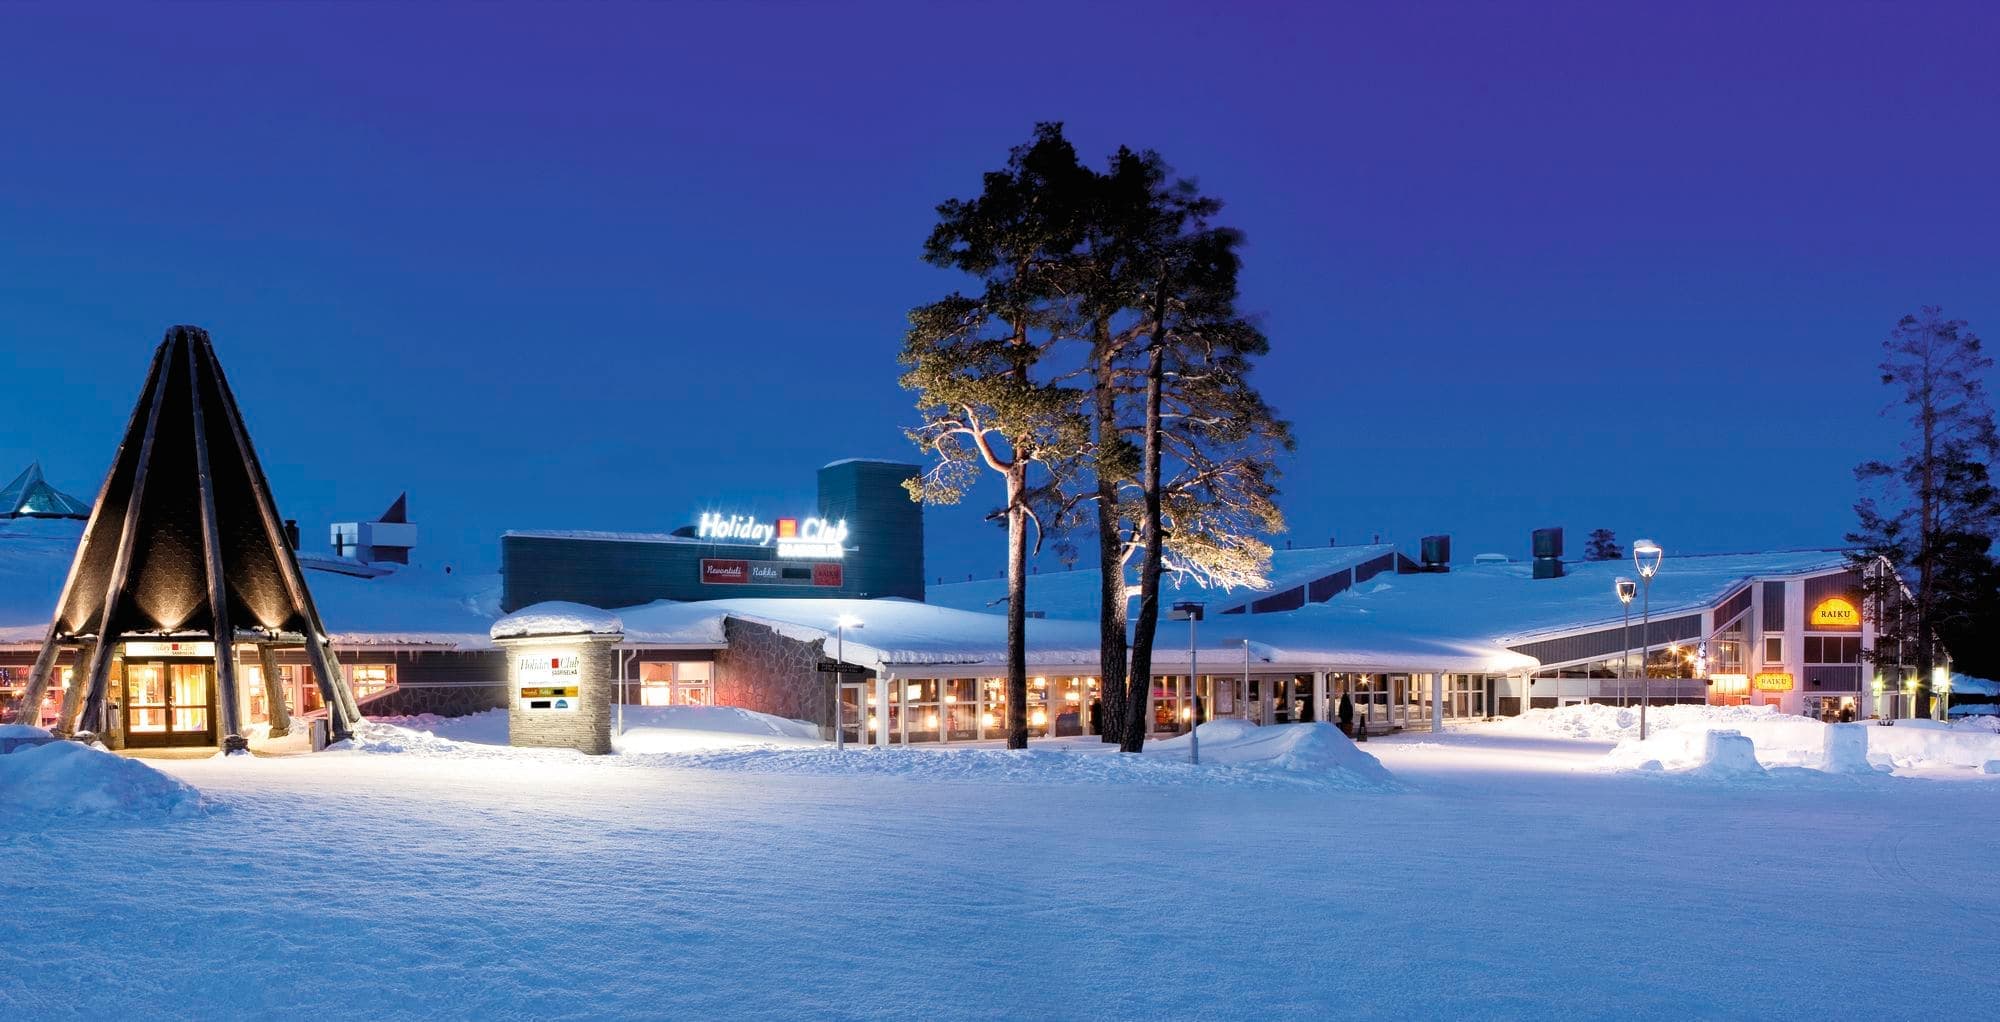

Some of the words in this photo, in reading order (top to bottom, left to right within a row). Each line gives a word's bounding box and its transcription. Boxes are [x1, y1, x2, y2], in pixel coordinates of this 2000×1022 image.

[700, 511, 775, 546] Holiday
[802, 517, 848, 542] Club
[706, 564, 742, 576] Revontuli
[752, 567, 778, 578] Rakka
[1821, 610, 1851, 618] RAIKU
[560, 656, 580, 669] Club
